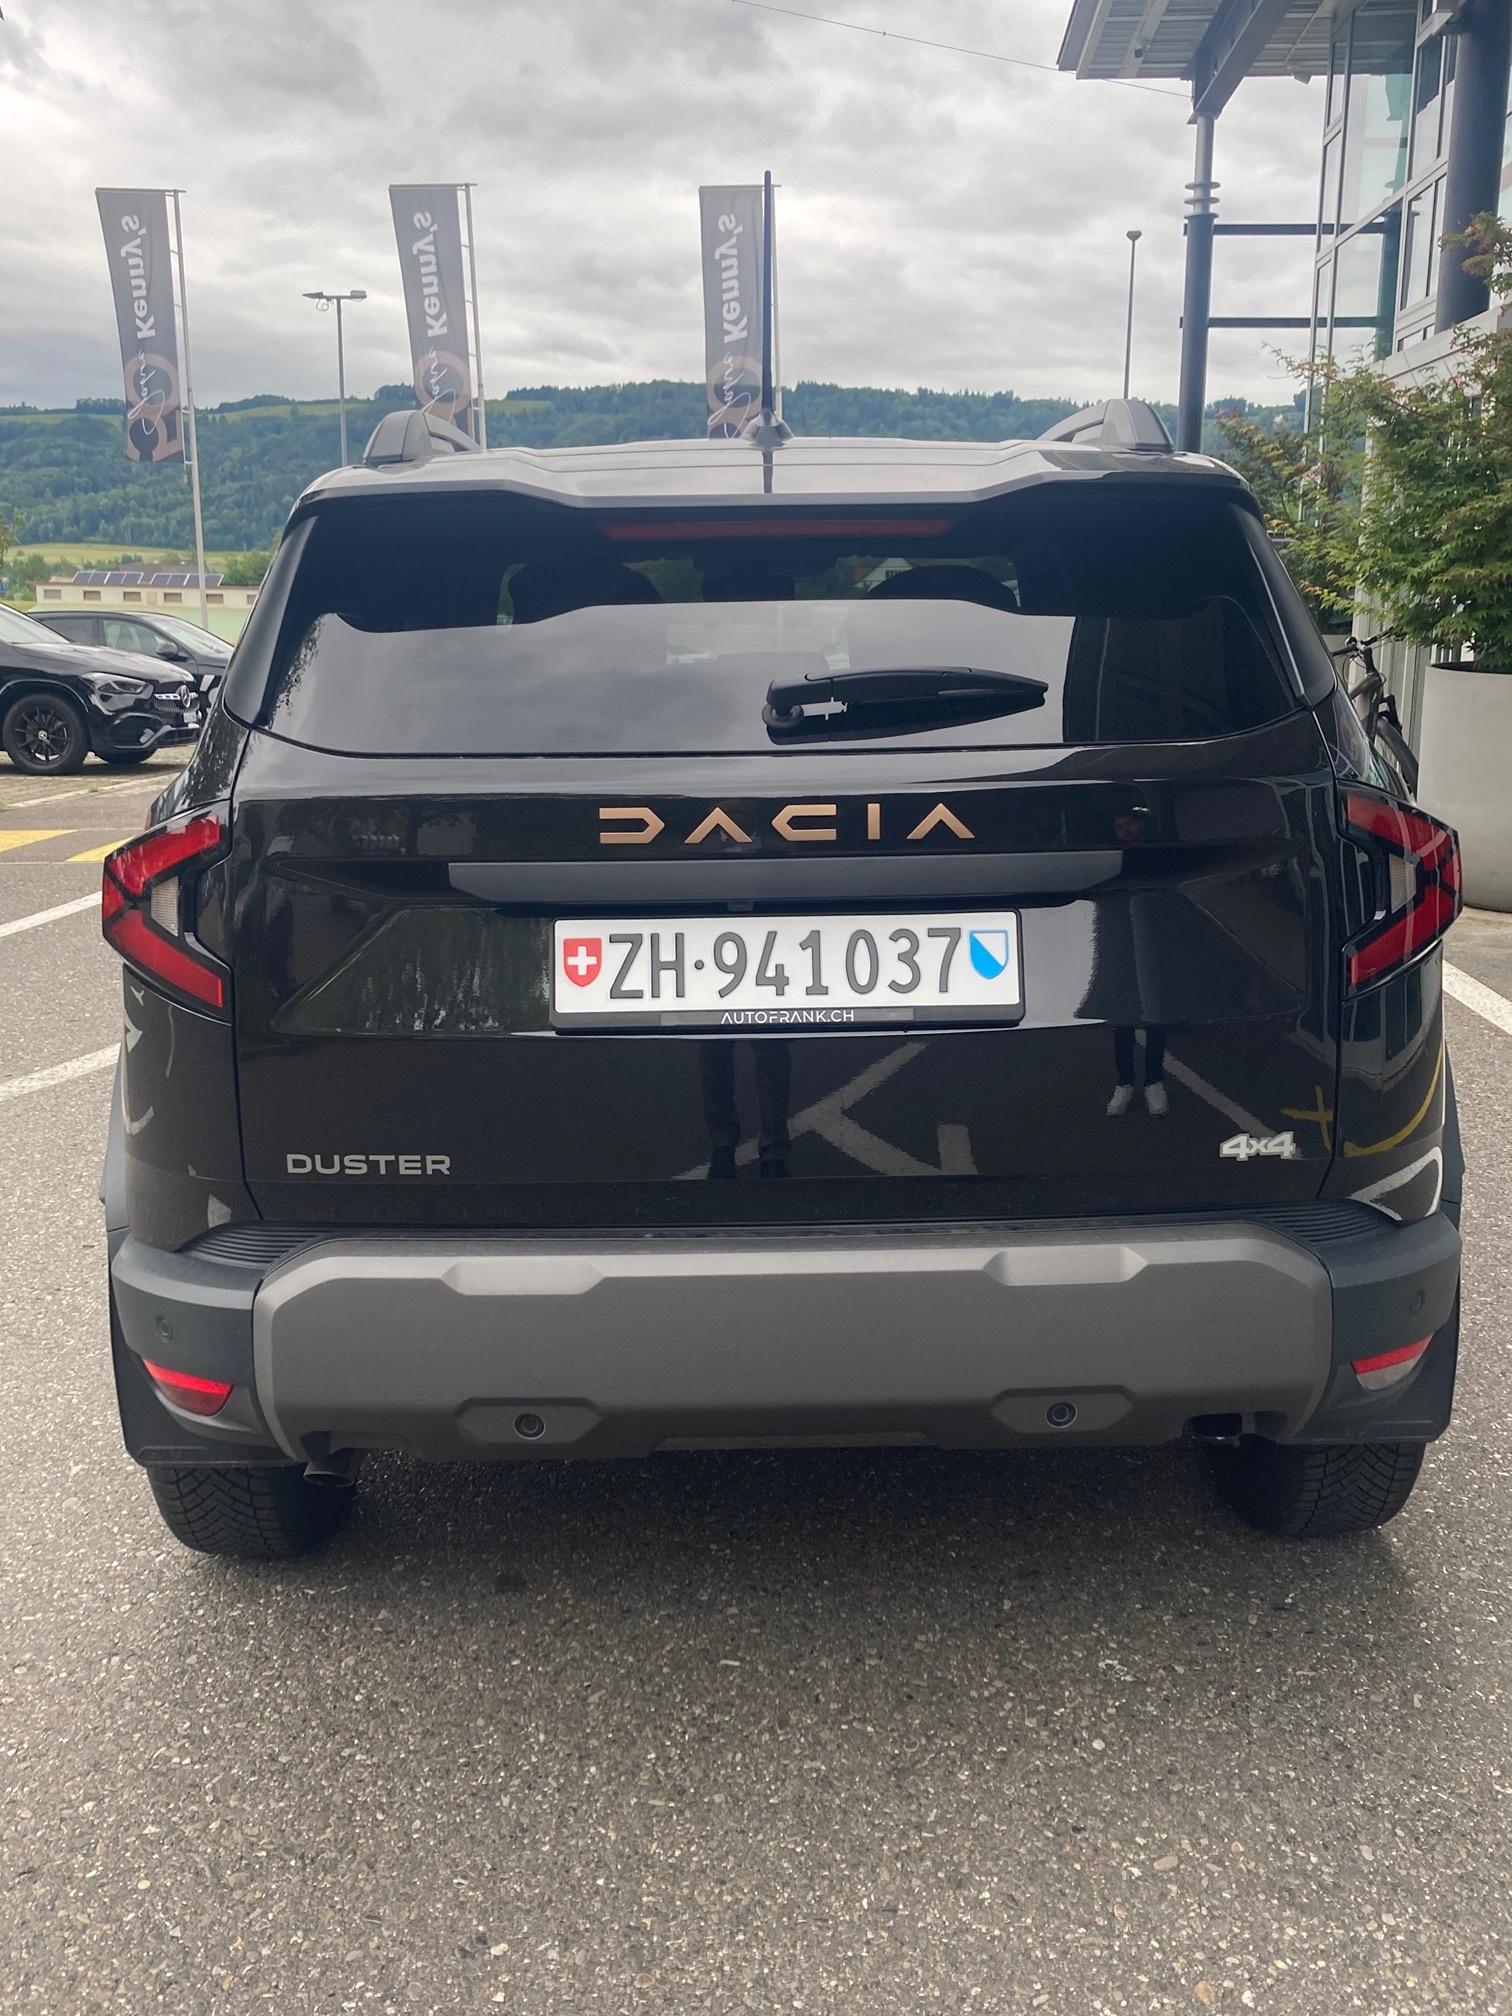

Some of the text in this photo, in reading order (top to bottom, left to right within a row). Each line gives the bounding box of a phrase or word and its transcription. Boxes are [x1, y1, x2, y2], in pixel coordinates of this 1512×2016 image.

[599, 802, 976, 844] DACIA
[721, 1009, 855, 1025] AUTOFRANK.CH
[1219, 1131, 1297, 1162] 4x4
[286, 1153, 451, 1175] DUSTER
